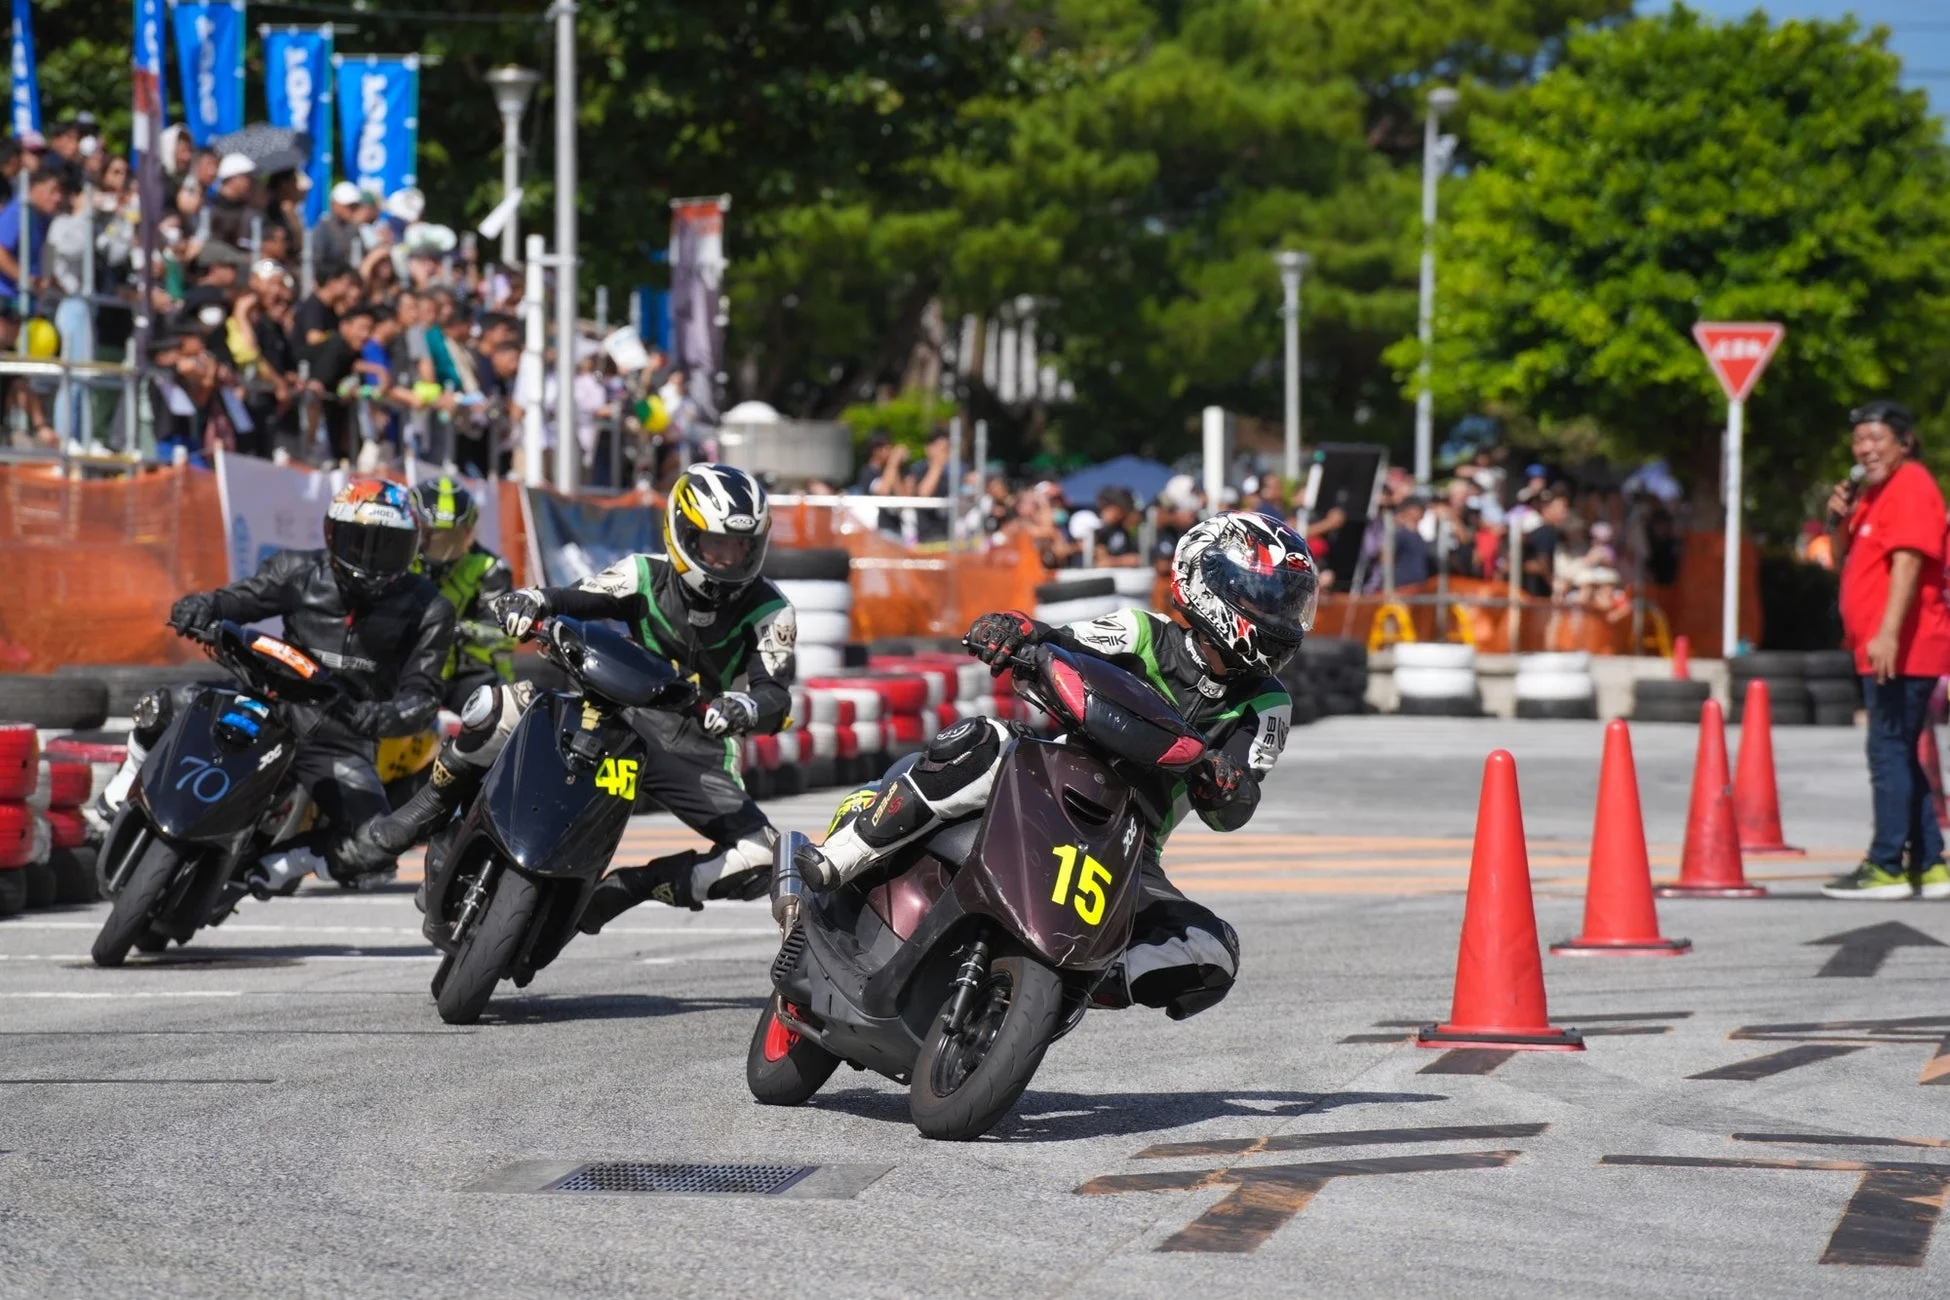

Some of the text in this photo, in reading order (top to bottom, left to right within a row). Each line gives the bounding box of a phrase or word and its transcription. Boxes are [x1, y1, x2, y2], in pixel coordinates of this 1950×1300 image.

[175, 755, 231, 803] 70
[595, 757, 638, 800] 46
[1051, 844, 1113, 926] 15
